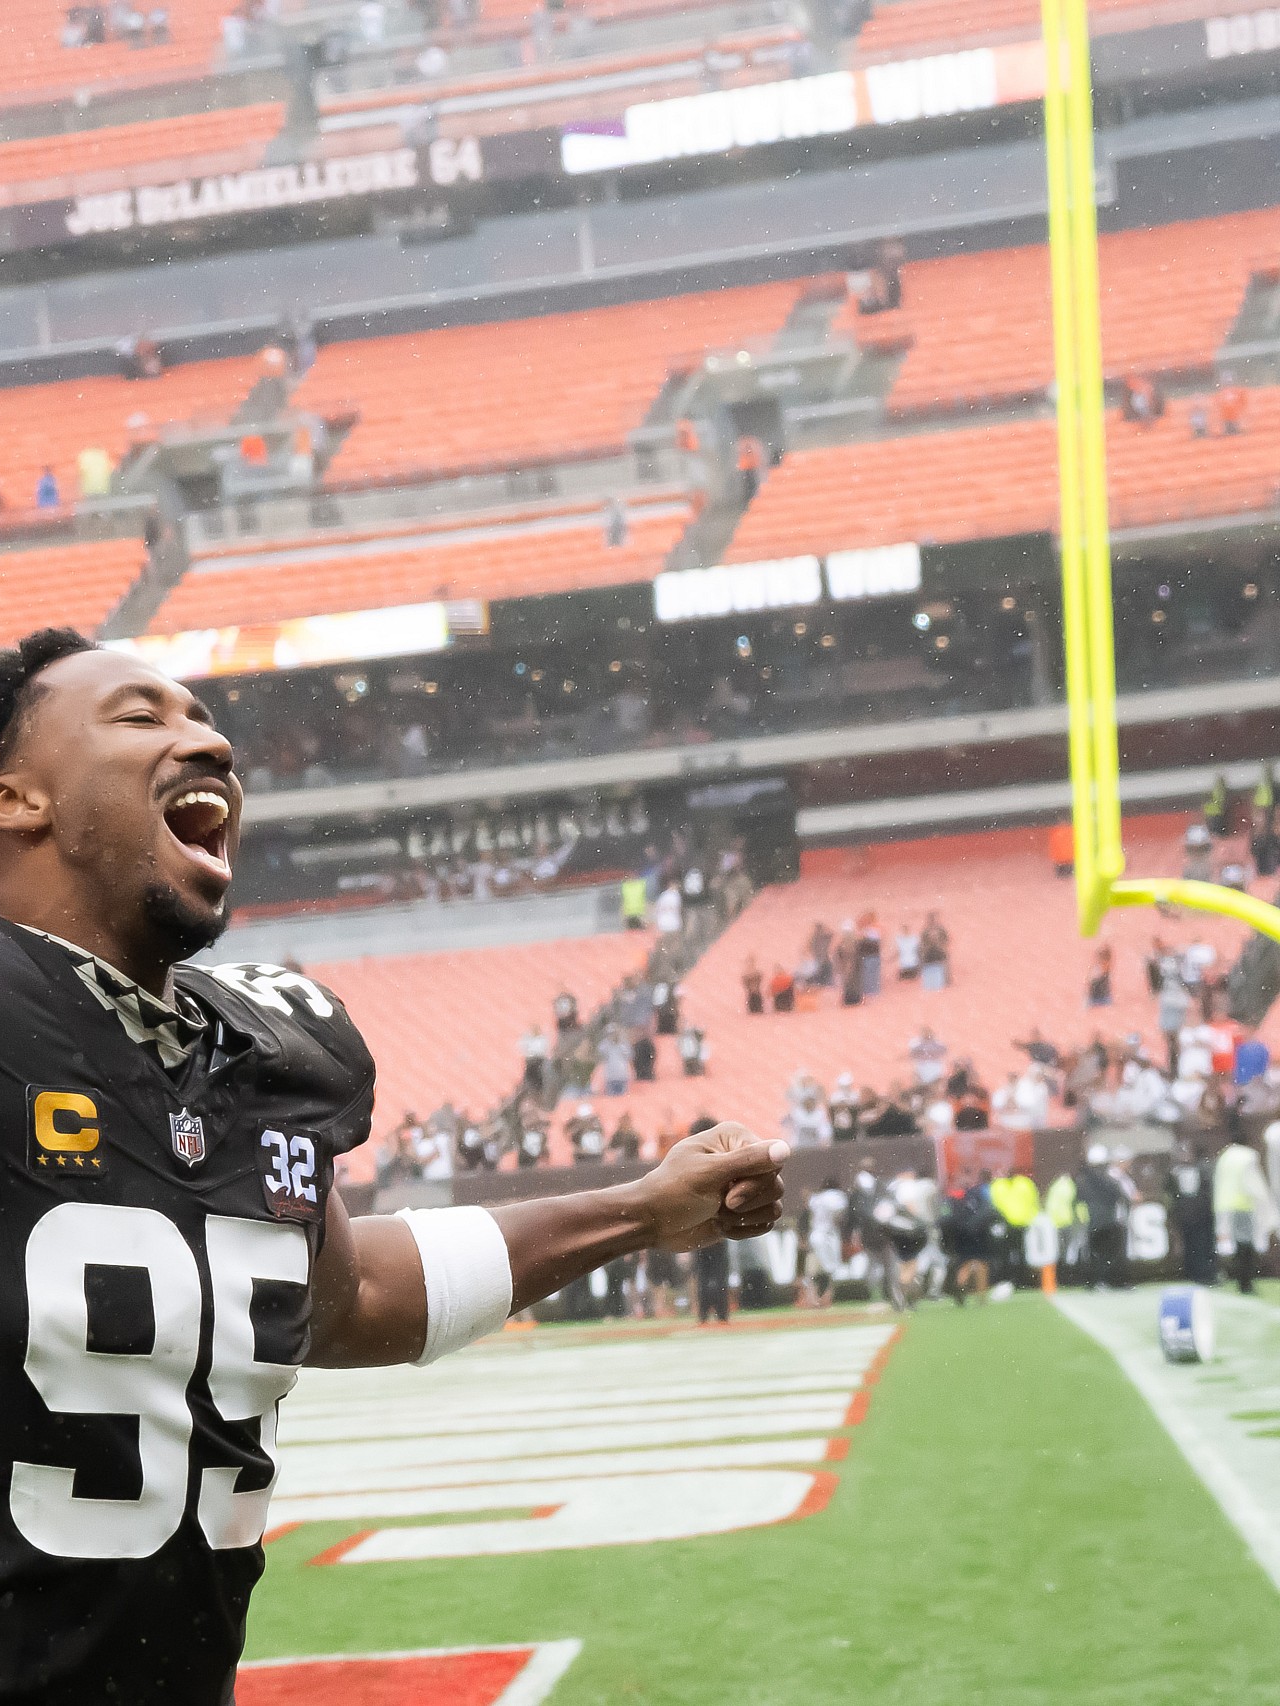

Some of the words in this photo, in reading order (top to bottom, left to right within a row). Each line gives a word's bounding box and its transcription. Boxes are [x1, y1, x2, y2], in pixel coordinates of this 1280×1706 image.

[429, 136, 483, 186] 64
[34, 1090, 100, 1152] C
[177, 1133, 202, 1156] NFL
[260, 1129, 318, 1204] 32
[9, 1202, 309, 1560] 95
